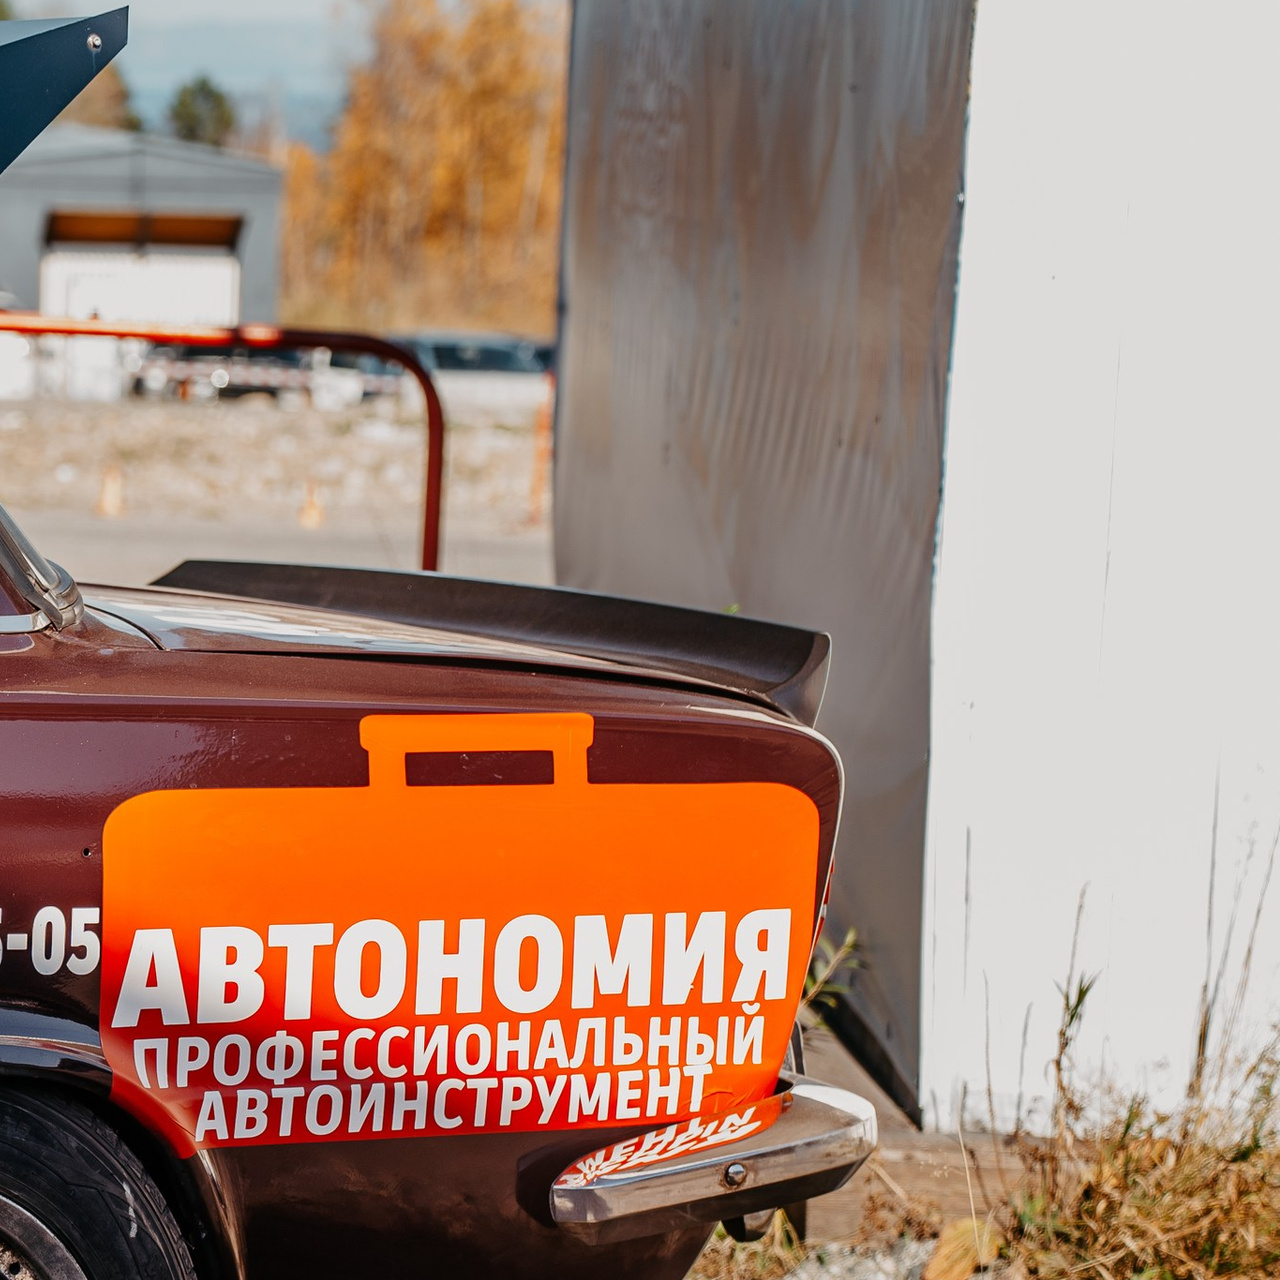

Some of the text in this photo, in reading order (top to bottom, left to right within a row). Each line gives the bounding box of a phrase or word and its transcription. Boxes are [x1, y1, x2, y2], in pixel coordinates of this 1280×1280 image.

[111, 908, 793, 1029] АВТОНОМИЯ
[133, 1000, 766, 1090] ПРОФЕССИОНАЛЬНЫЙ
[195, 1063, 713, 1142] АВТОИНСТРУМЕНТ
